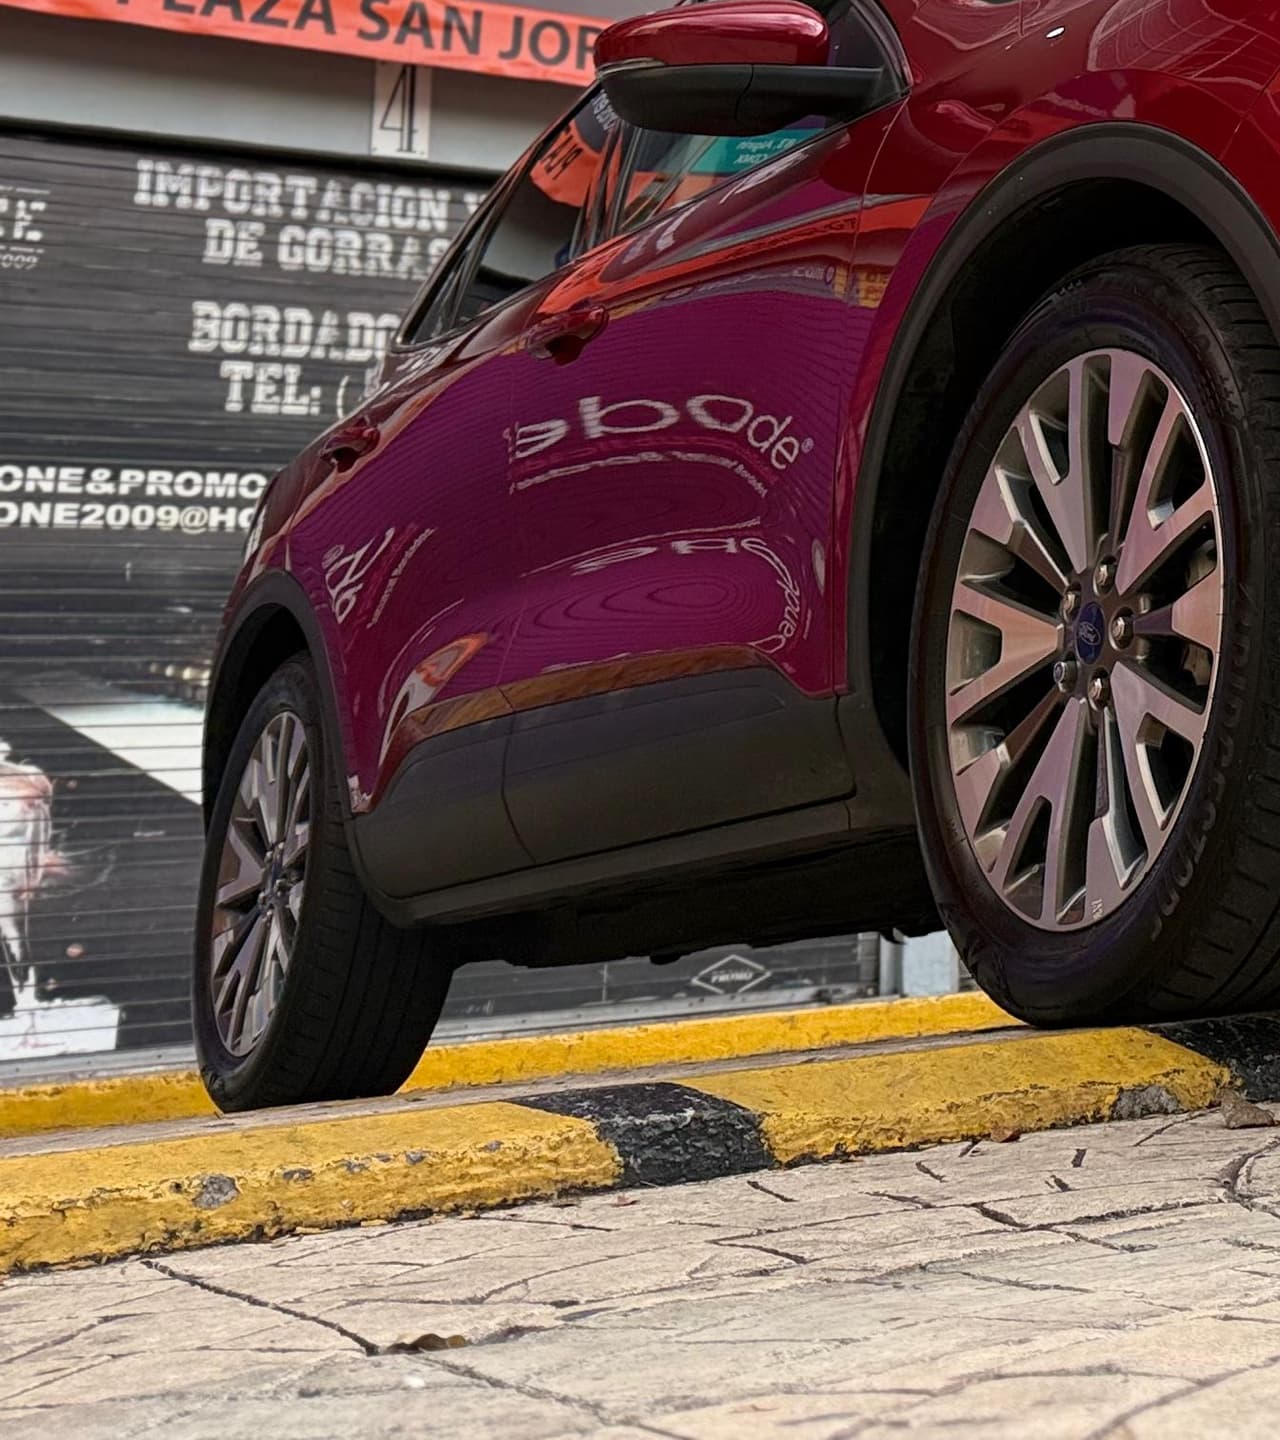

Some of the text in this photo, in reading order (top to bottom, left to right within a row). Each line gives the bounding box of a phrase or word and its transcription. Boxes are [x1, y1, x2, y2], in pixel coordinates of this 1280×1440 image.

[378, 63, 418, 154] 4
[134, 159, 450, 234] IMPORTACION
[202, 217, 266, 267] DE
[219, 359, 322, 417] TEL:
